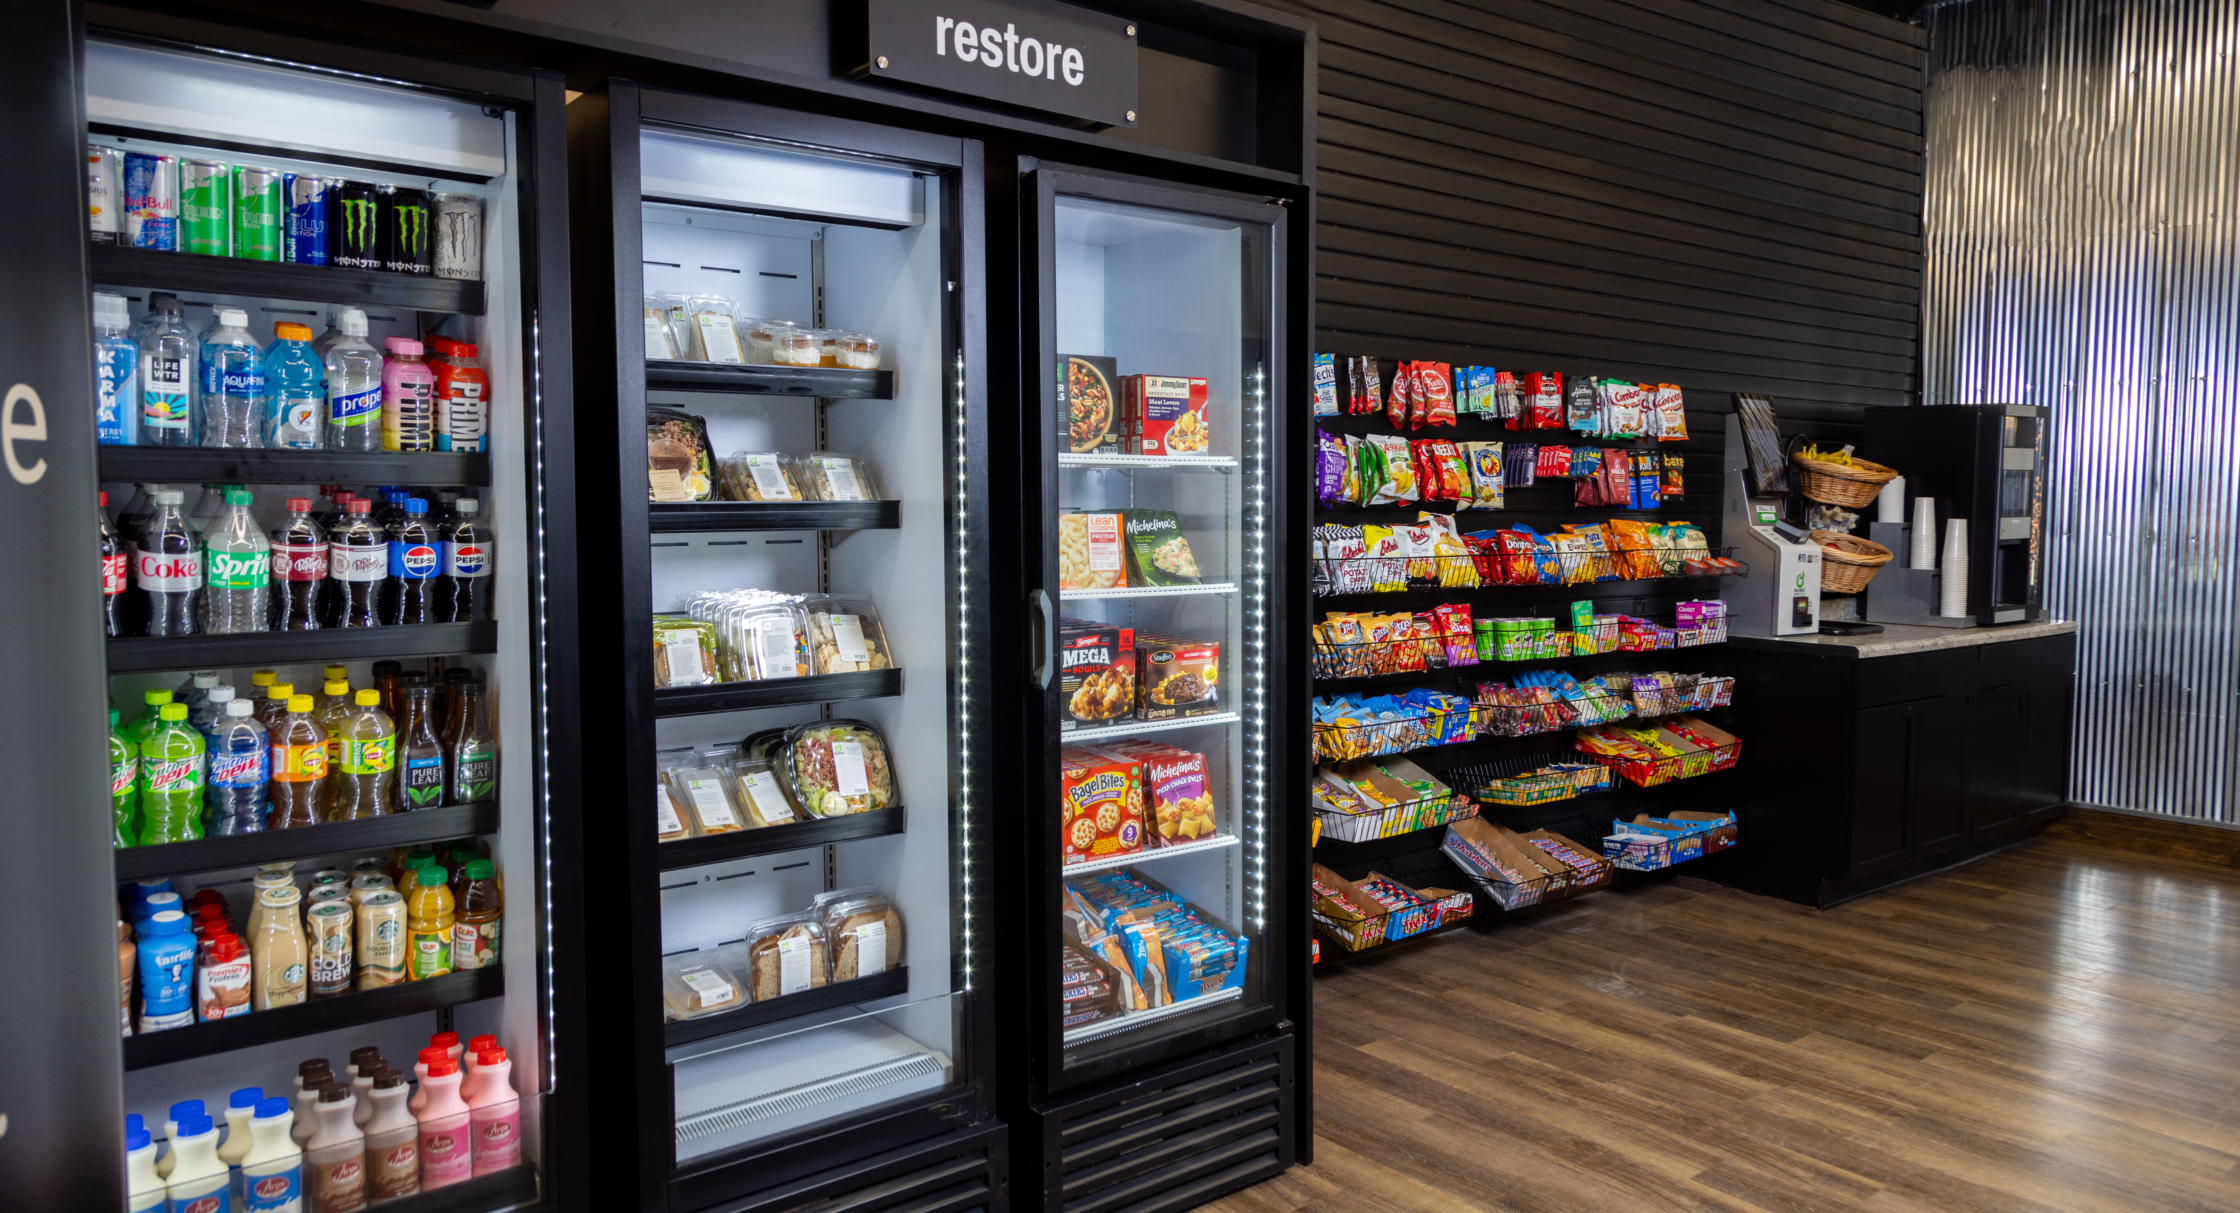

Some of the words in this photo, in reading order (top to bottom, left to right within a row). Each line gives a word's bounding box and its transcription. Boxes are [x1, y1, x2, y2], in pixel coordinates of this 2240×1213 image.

[936, 16, 1084, 86] restore
[146, 196, 172, 210] Bull
[153, 361, 179, 371] LIFE
[153, 370, 179, 380] WTR
[101, 350, 116, 422] KARMA
[449, 381, 482, 453] PRIME
[1588, 451, 1602, 460] Advil
[1664, 453, 1685, 467] bare
[1324, 464, 1344, 475] CHIPS
[1090, 516, 1115, 525] Lean
[1126, 519, 1177, 535] Michelina's
[294, 556, 322, 572] Pepper
[352, 557, 379, 573] Pepper
[406, 556, 435, 565] PEPSI
[455, 555, 485, 564] PEPSI
[141, 555, 198, 578] Coke
[1450, 624, 1470, 633] bits
[1062, 647, 1111, 669] MEGA
[1072, 664, 1101, 674] BOWLS
[365, 751, 384, 761] Lipton
[303, 757, 321, 767] Lipton
[464, 761, 491, 771] PURE
[412, 767, 439, 778] PURE
[1151, 759, 1200, 783] Michelina's
[412, 775, 439, 786] LEAF
[1156, 784, 1170, 796] PIZZA
[1170, 777, 1188, 789] SNACK
[1187, 774, 1203, 783] ROLLS
[1068, 773, 1100, 803] Bagel
[1100, 773, 1125, 790] Bites
[1127, 826, 1133, 838] 9
[1455, 842, 1493, 872] Musketeers
[458, 926, 474, 936] Dole
[422, 942, 438, 950] Dole
[155, 949, 194, 967] fairlife
[374, 948, 400, 957] ENERGY
[312, 953, 352, 970] COLD
[207, 966, 243, 977] Premier
[312, 967, 351, 982] BREW
[208, 972, 240, 983] Protein
